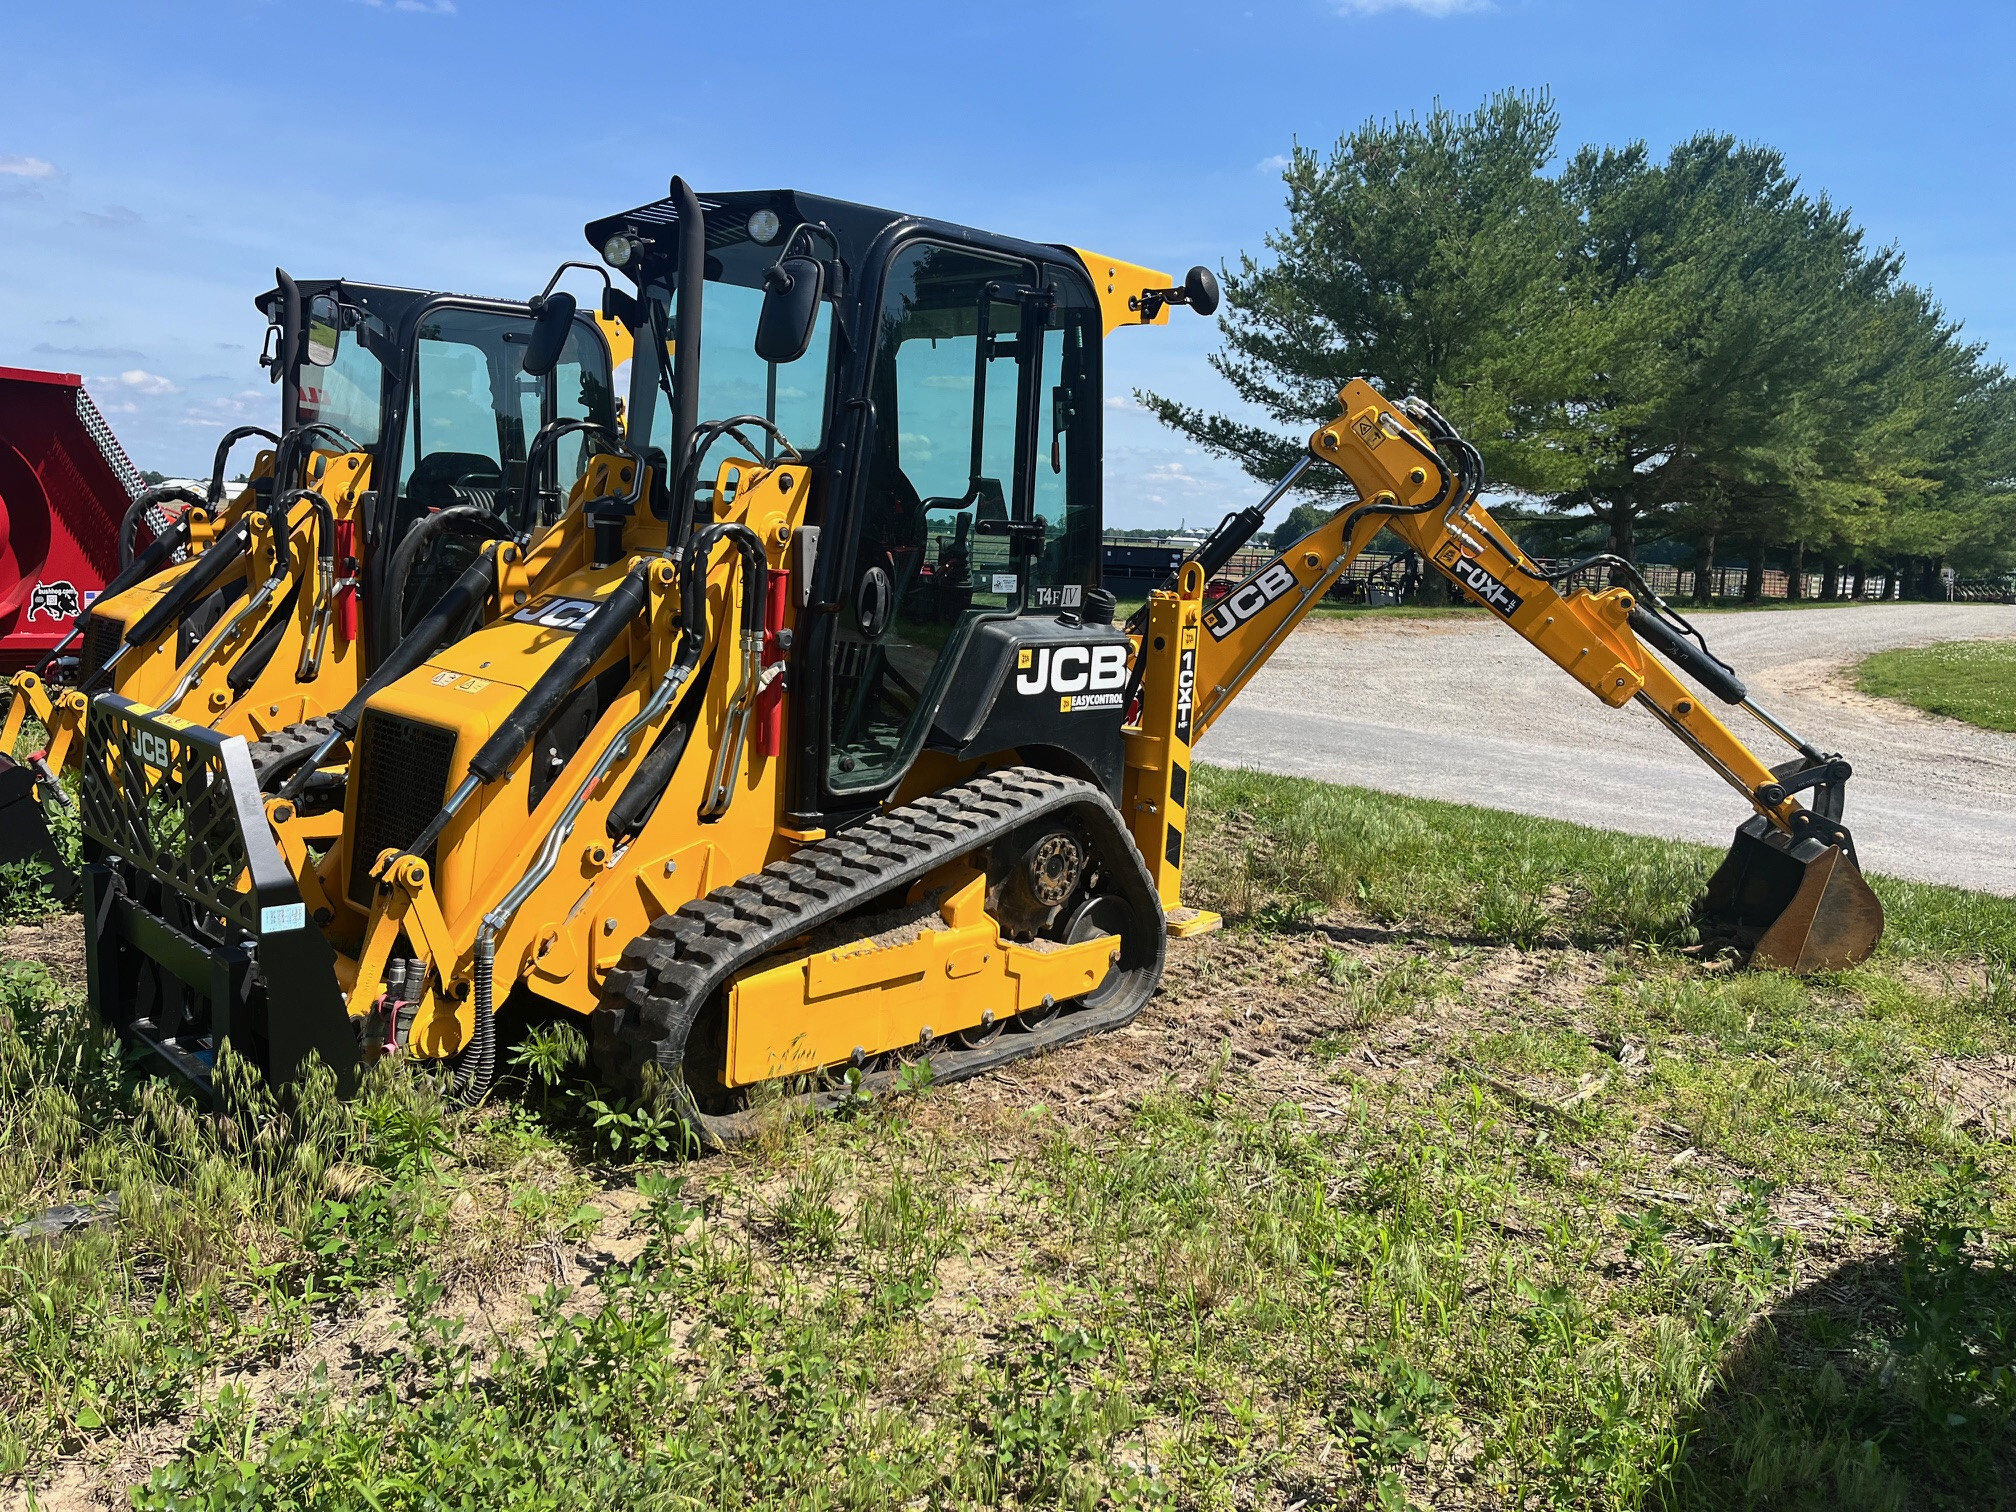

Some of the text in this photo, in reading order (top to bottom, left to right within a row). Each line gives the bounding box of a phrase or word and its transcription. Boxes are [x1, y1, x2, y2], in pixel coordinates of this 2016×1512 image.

[38, 588, 75, 596] bushhog.com
[1212, 564, 1294, 637] JCB
[1505, 599, 1517, 613] HF
[1017, 646, 1127, 695] JCB
[1177, 651, 1193, 721] 1CXT
[1071, 693, 1123, 707] EASYCONTROL
[1177, 720, 1188, 729] HF
[131, 728, 169, 768] JCB
